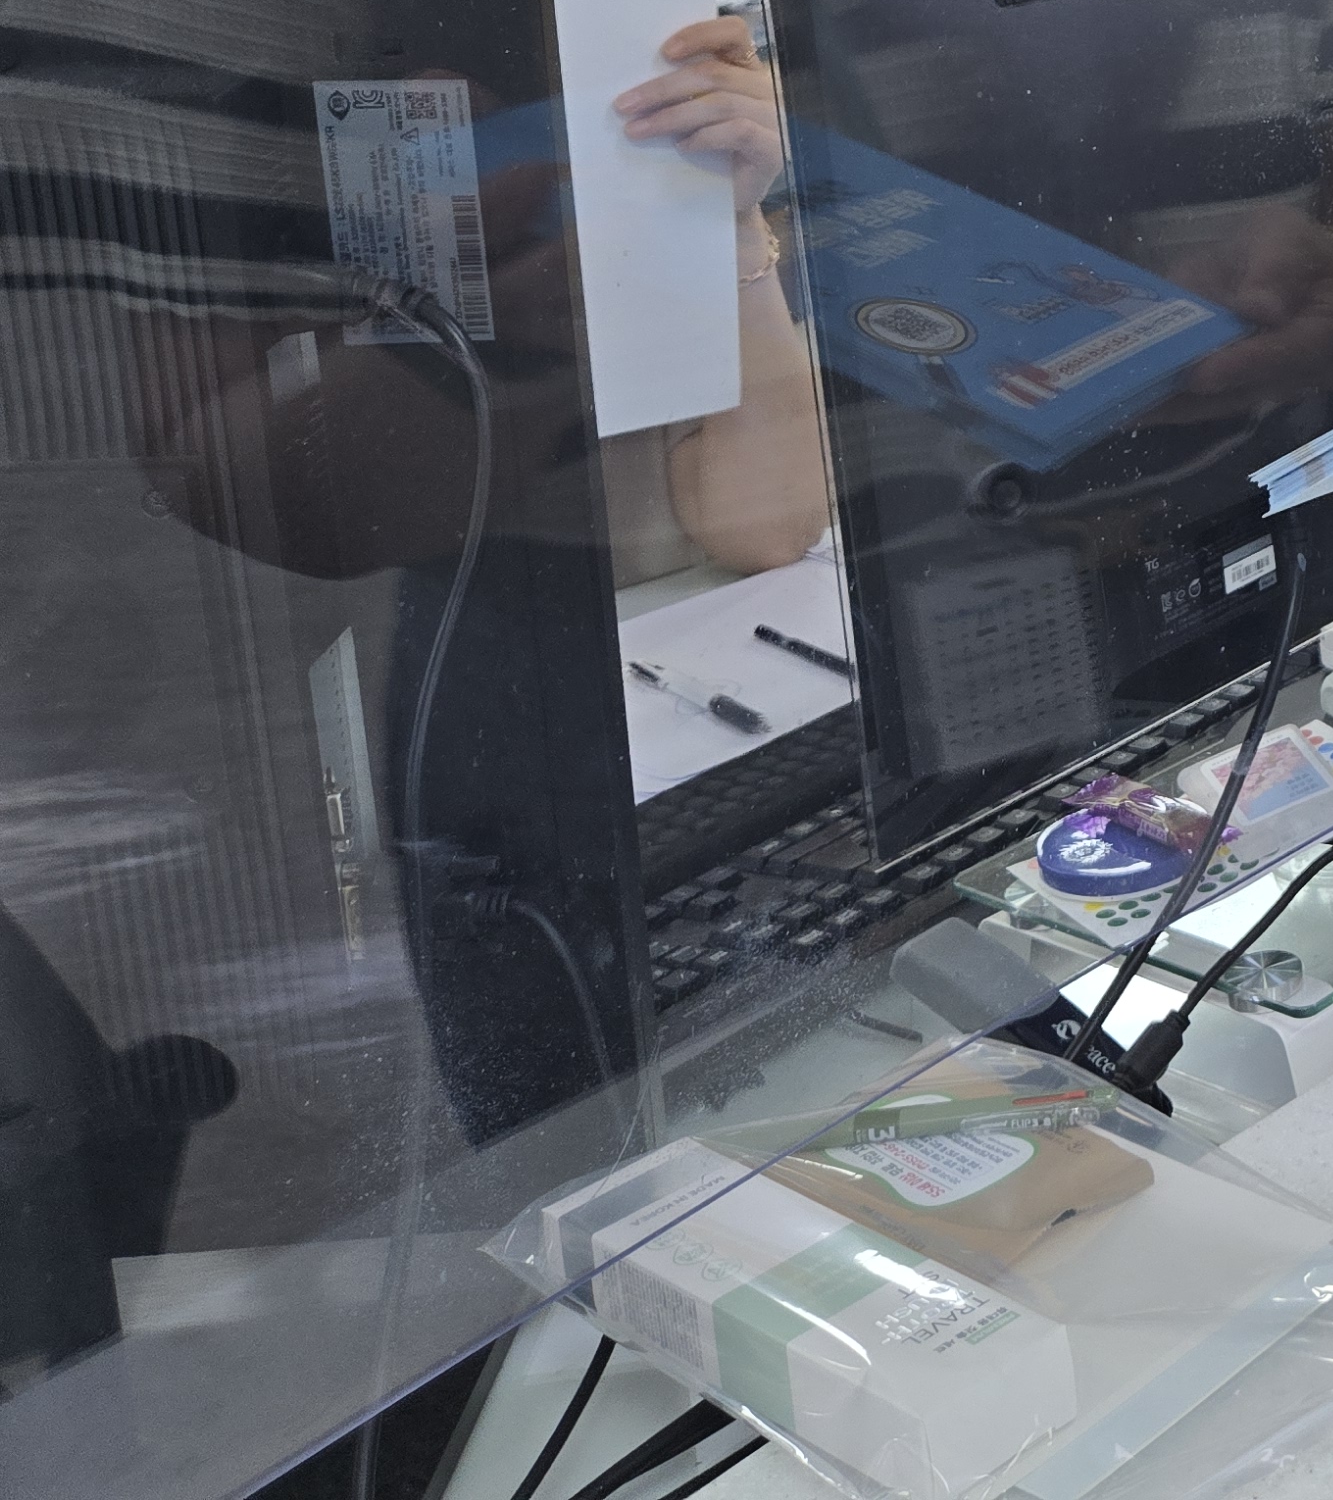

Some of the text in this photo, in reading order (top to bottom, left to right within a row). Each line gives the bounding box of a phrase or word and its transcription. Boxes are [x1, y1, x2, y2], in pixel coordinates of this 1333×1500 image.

[688, 1174, 725, 1198] MADE
[630, 1200, 676, 1227] KOREA
[901, 1294, 991, 1344] TRAVEL
